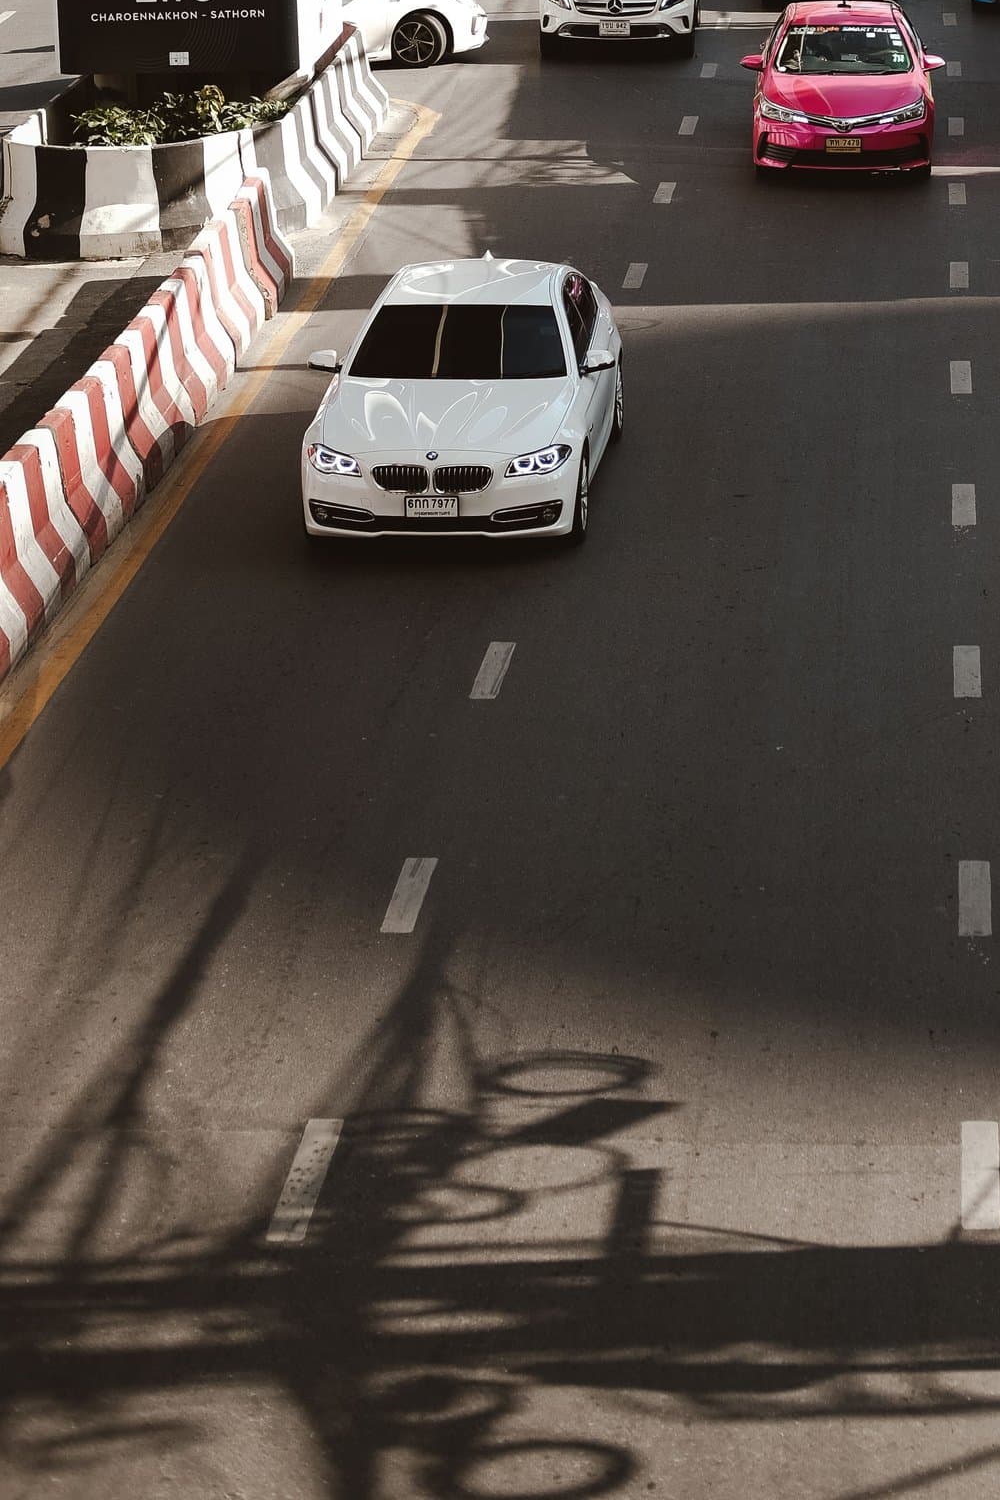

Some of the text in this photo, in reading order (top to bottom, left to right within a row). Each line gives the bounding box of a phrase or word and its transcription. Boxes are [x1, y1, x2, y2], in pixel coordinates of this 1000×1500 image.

[90, 11, 198, 22] CHAROENNAKHON
[210, 9, 265, 19] SATHORN
[407, 498, 456, 509] 6กก 7977
